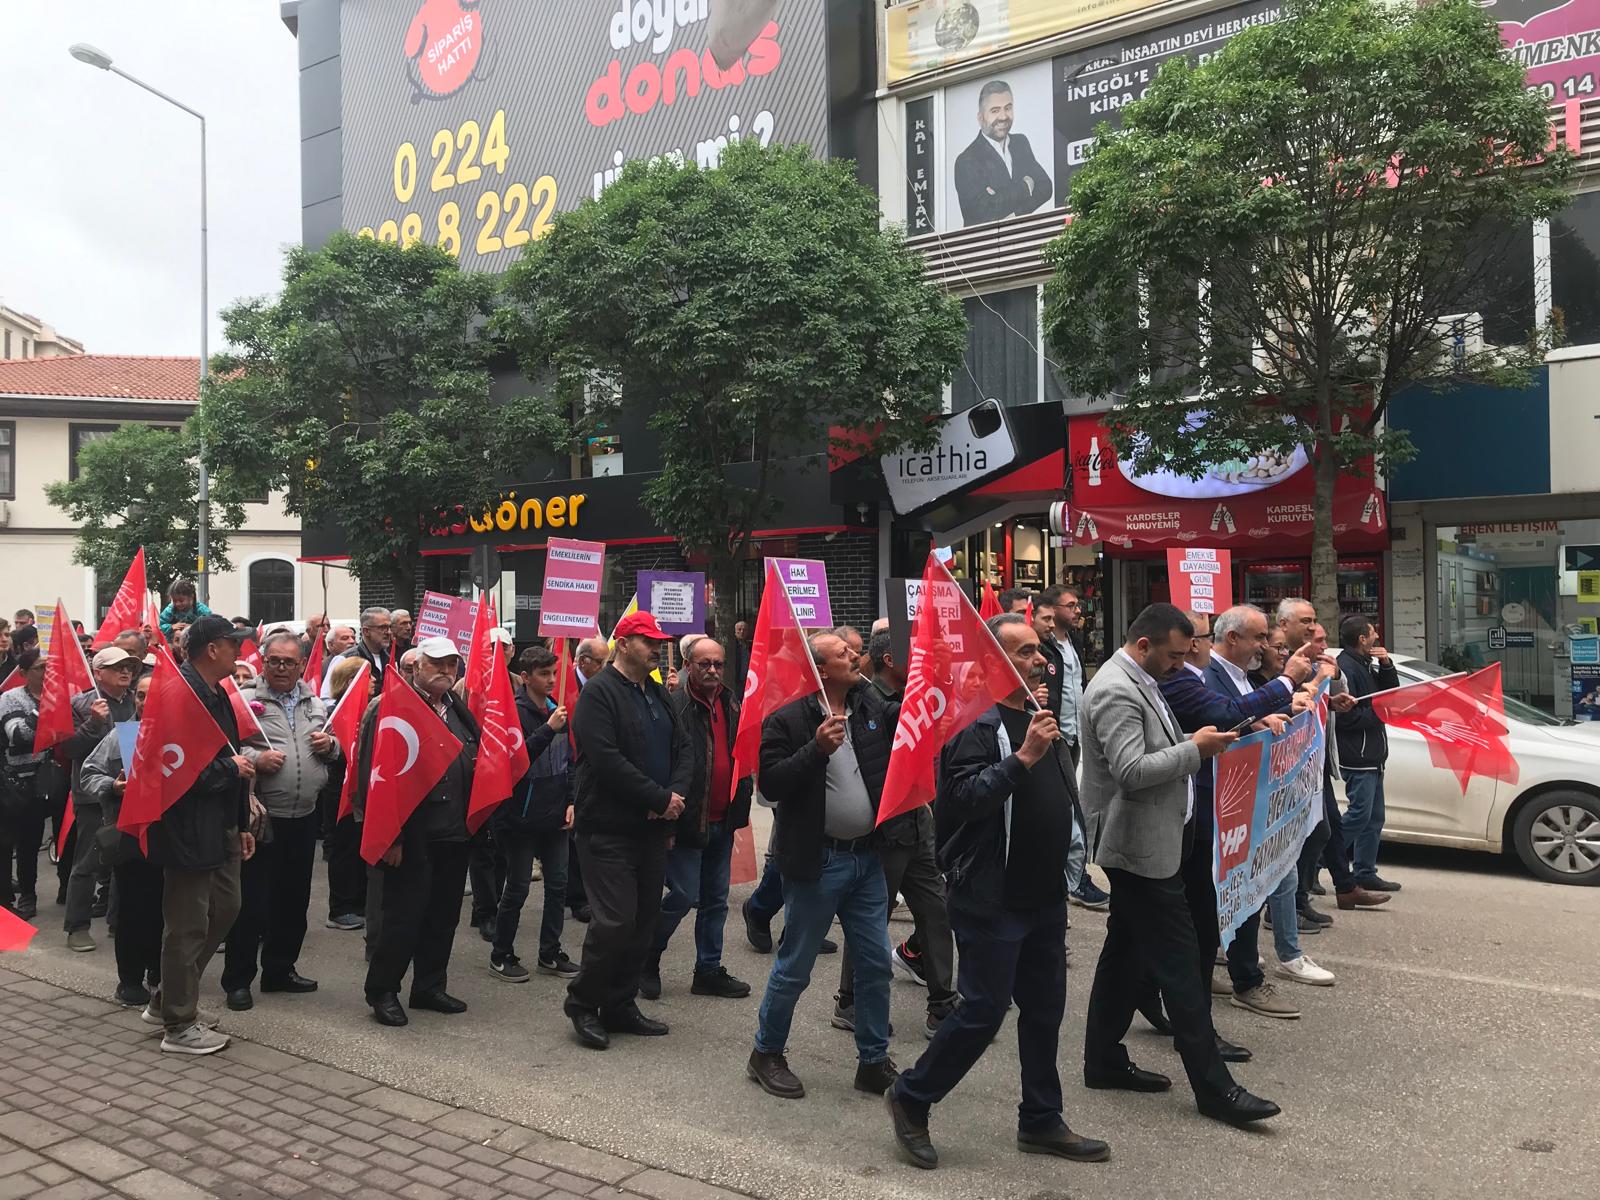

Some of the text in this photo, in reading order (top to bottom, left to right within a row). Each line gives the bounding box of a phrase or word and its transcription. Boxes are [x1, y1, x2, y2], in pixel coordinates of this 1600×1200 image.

[427, 14, 474, 63] SİPARİŞ
[1121, 35, 1181, 63] İNŞAATIN
[1184, 24, 1213, 45] DEVİ
[1217, 8, 1280, 36] HERKESİN
[437, 37, 472, 75] HATTI
[1563, 74, 1594, 97] 14
[1090, 92, 1134, 114] KİRA
[394, 142, 417, 203] 0
[431, 109, 510, 192] 224
[913, 168, 928, 228] EMLAK
[476, 175, 558, 256] 222
[900, 443, 987, 477] icathia
[1266, 504, 1314, 514] KARDEŞL
[1126, 512, 1181, 523] KARDEŞLER
[1267, 513, 1315, 523] KURUYEM
[1126, 520, 1180, 530] KURUYEMİŞ
[1461, 524, 1495, 536] EREN
[1187, 551, 1214, 560] EMEK VE
[790, 568, 806, 577] HAK
[547, 579, 595, 591] SENDİKA HAKKI
[787, 585, 816, 595] ERİLMEZ
[907, 584, 953, 600] ÇALŞMA
[427, 597, 451, 608] SARAYA
[423, 611, 447, 621] SAVAŞA
[796, 607, 815, 617] LINIR
[543, 614, 589, 624] ENGELLENEMEZ
